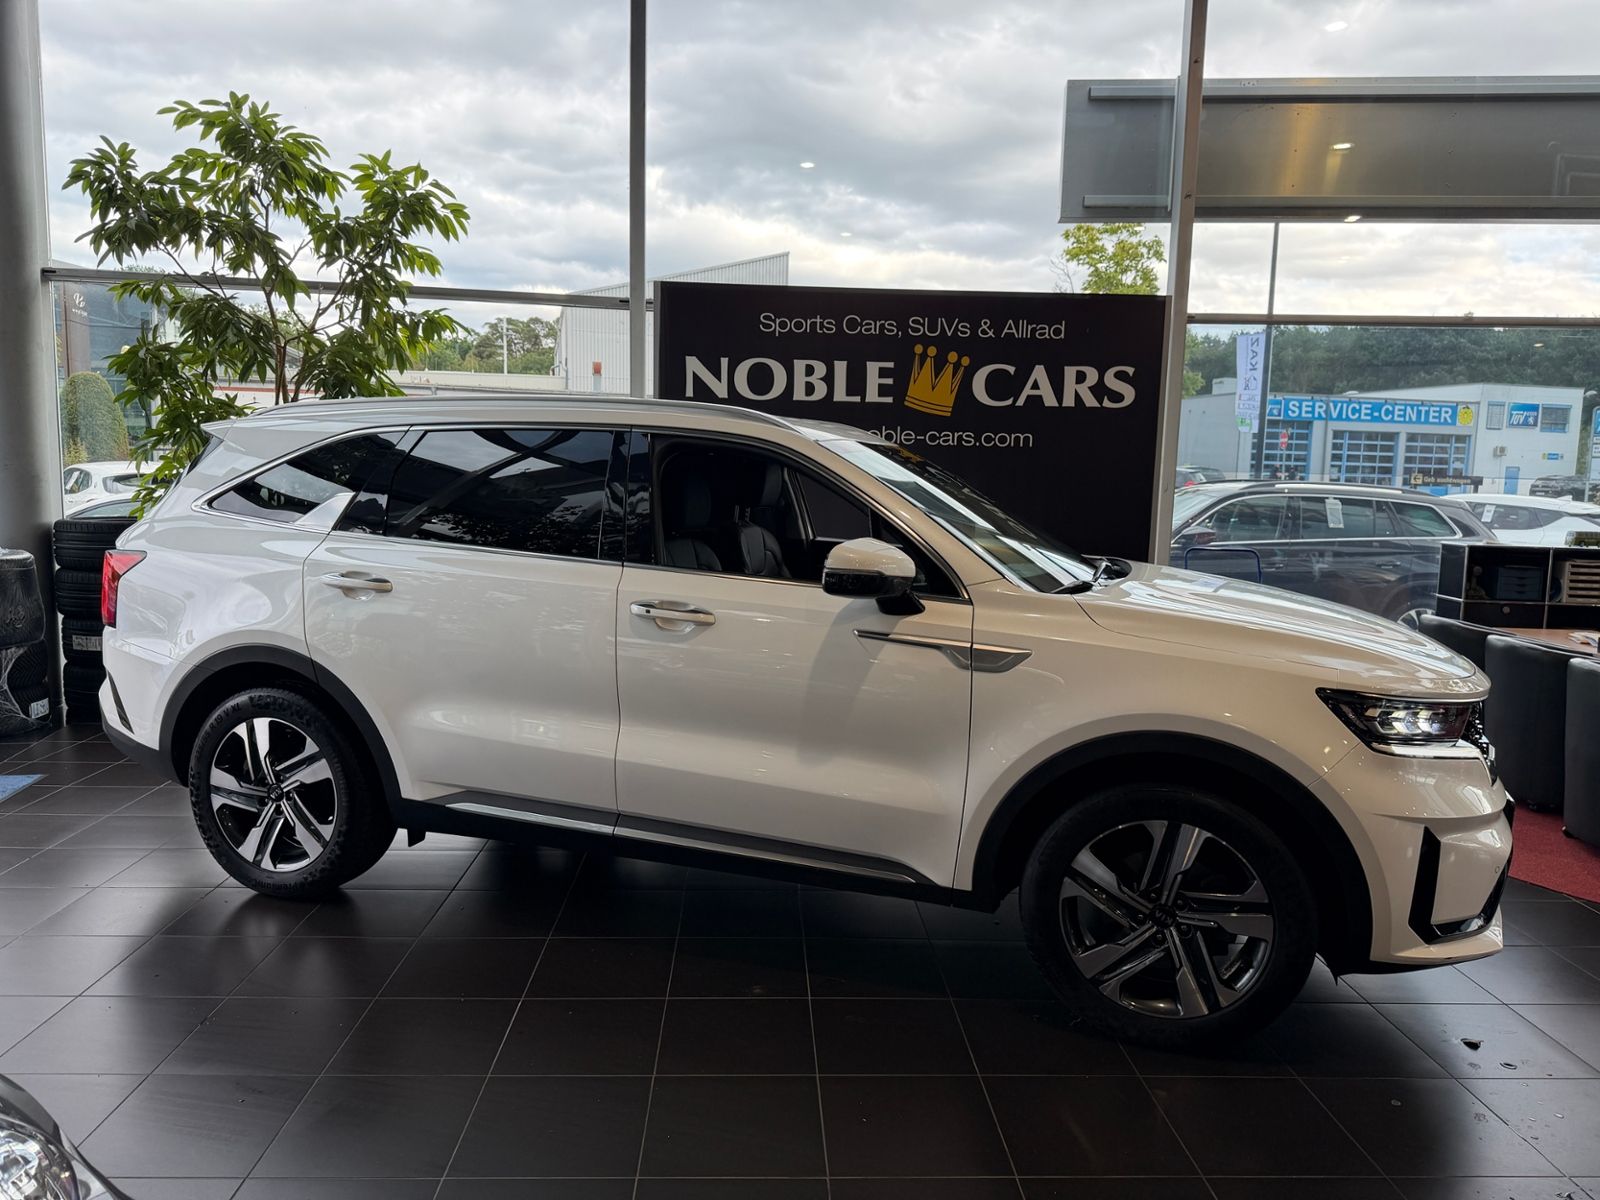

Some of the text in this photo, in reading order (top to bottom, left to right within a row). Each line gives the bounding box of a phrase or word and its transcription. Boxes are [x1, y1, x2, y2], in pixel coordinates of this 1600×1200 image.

[759, 313, 1066, 340] Sports Cars, SUVs & Allrad
[685, 355, 1136, 409] NOBLE CARS
[1287, 401, 1452, 423] SERVICE-CENTER
